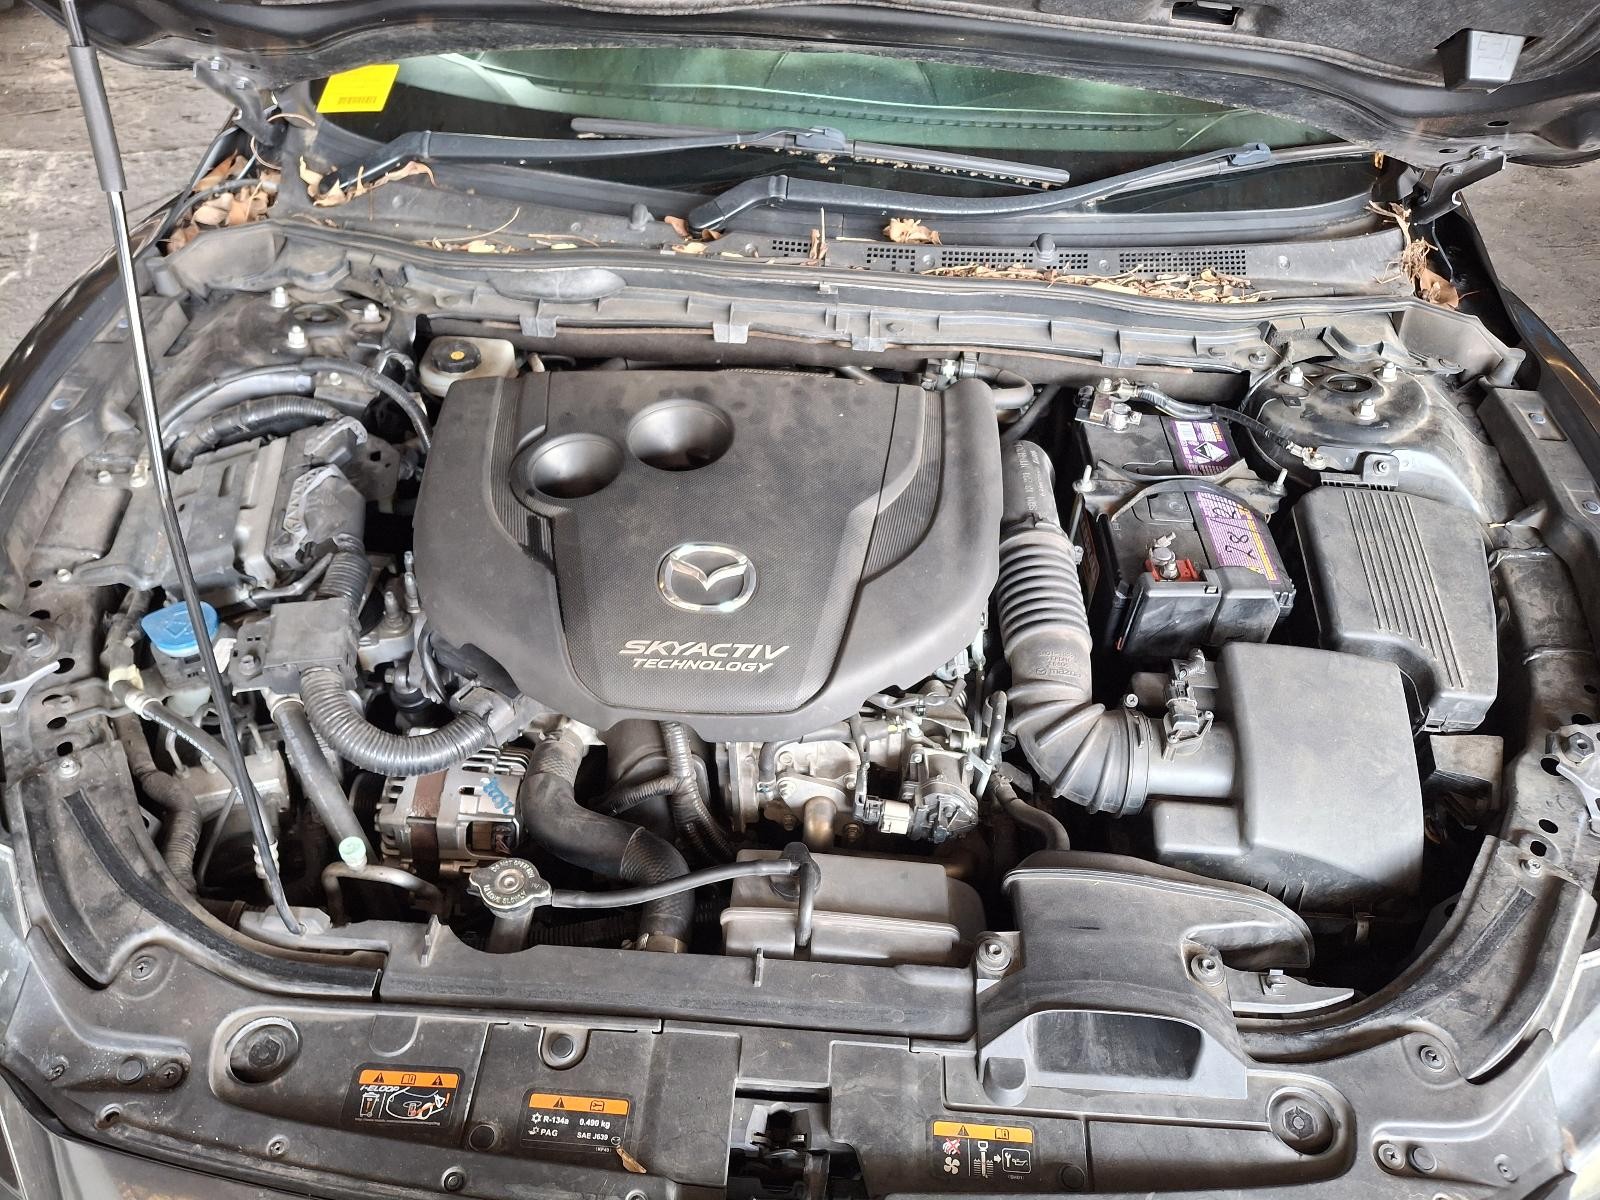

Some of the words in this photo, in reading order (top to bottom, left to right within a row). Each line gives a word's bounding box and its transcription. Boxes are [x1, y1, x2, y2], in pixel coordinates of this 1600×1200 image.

[619, 640, 790, 660] SKYACTIV
[633, 658, 774, 673] TECHNOLOGY
[543, 1115, 569, 1125] R-134a
[601, 1119, 611, 1129] kg
[540, 1128, 558, 1137] PAG
[577, 1131, 591, 1140] SAE
[592, 1133, 609, 1141] J639
